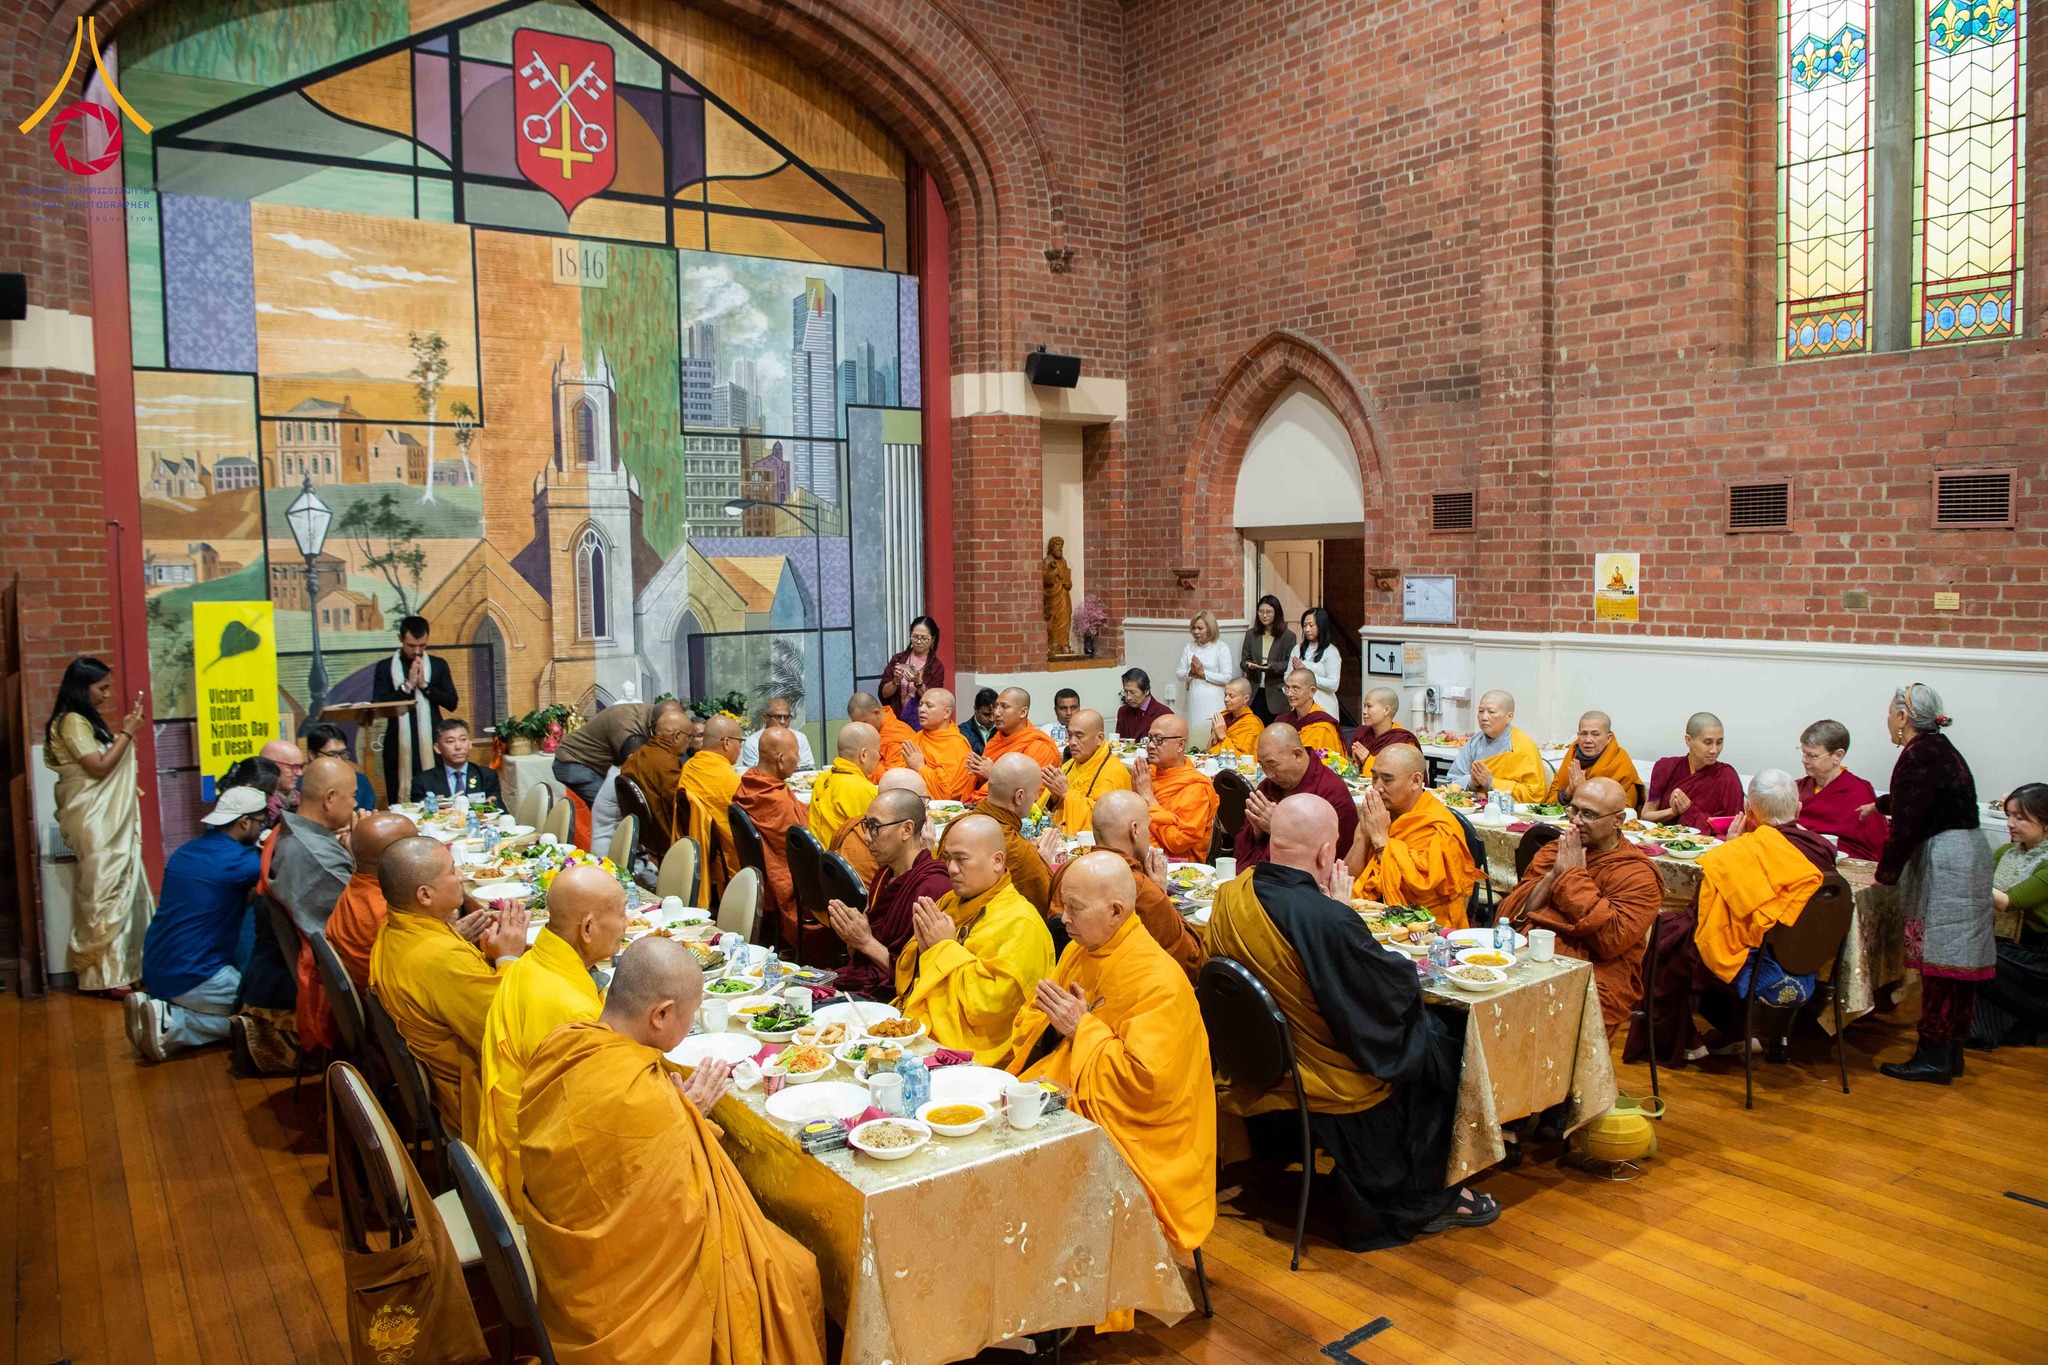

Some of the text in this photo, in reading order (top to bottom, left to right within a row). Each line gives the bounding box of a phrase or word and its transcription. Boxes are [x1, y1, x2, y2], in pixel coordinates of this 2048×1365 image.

[558, 247, 604, 280] 1846
[208, 688, 254, 704] Victorian
[210, 705, 241, 721] United
[211, 721, 269, 739] Nations Day
[212, 739, 253, 757] of Vesak
